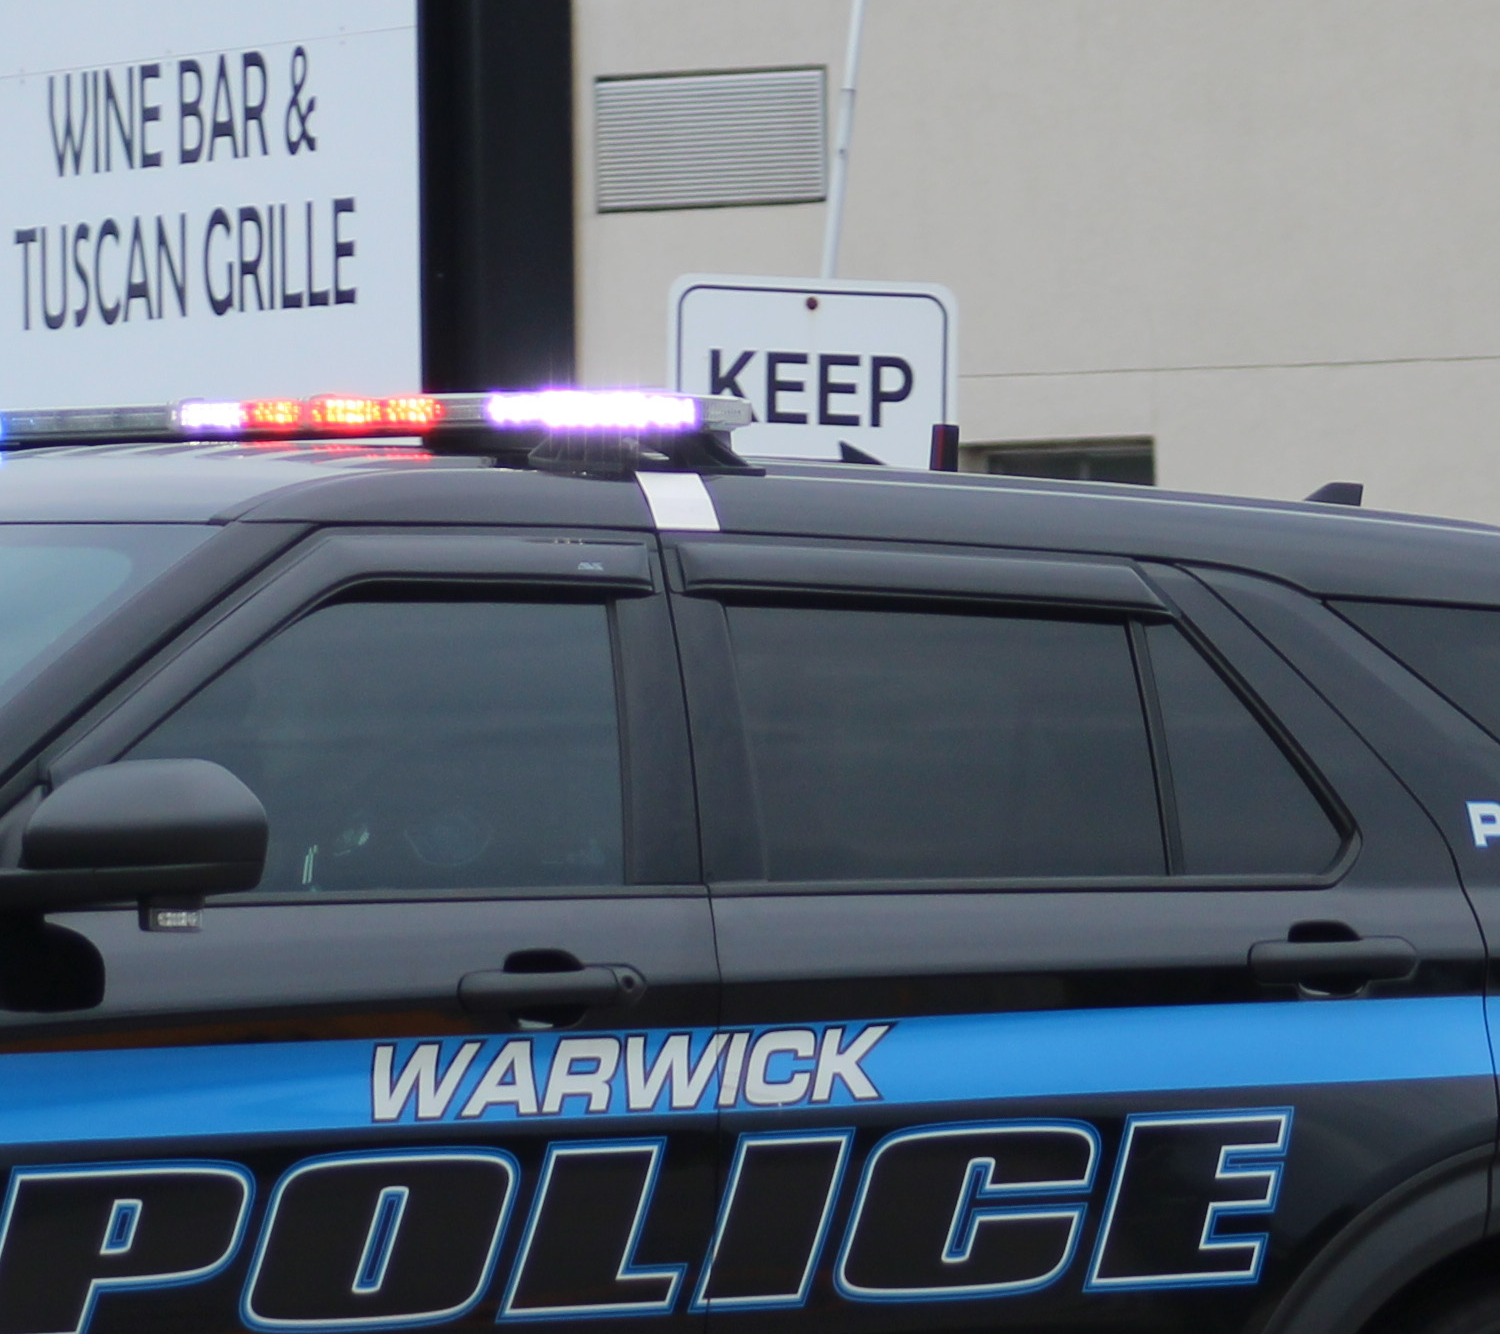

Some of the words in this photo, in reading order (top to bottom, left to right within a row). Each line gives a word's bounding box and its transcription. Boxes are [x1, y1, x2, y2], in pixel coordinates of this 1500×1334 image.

[48, 63, 162, 178] WINE
[177, 50, 270, 166] BAR
[285, 45, 317, 156] &
[14, 212, 187, 332] TUSCAN
[203, 197, 357, 316] GRILLE
[709, 348, 914, 428] KEEP
[369, 1023, 897, 1123] WARWICK
